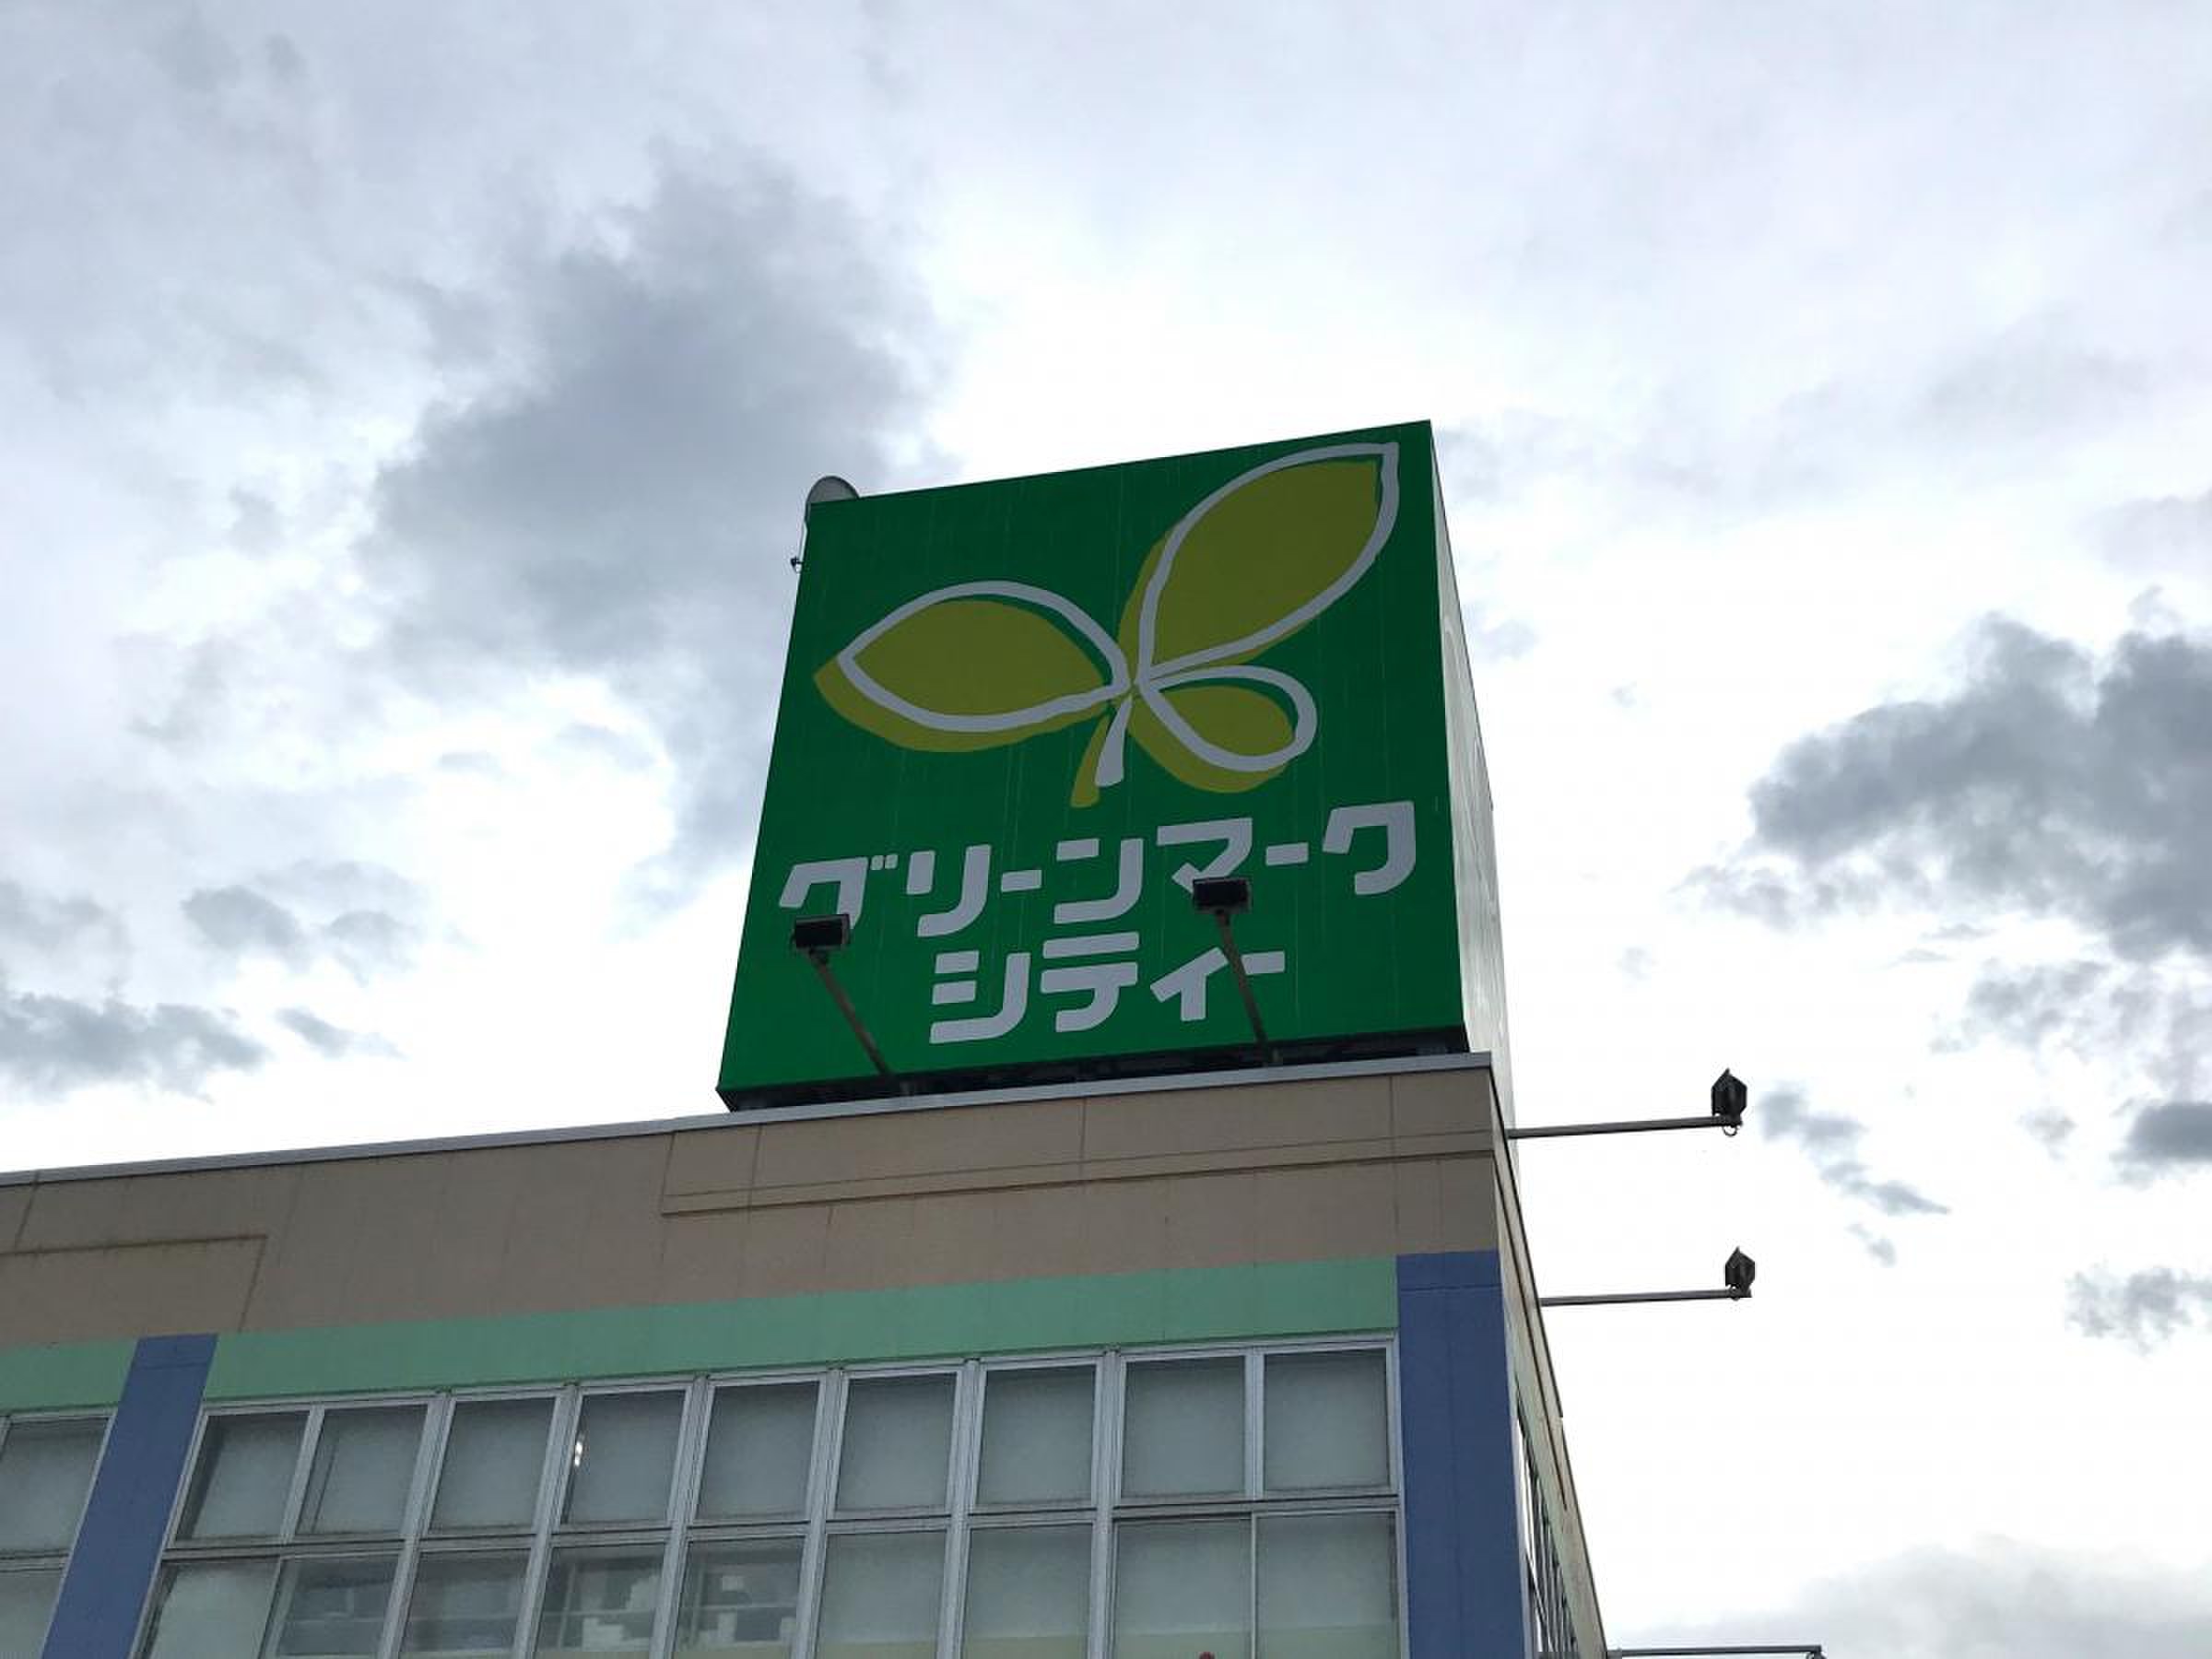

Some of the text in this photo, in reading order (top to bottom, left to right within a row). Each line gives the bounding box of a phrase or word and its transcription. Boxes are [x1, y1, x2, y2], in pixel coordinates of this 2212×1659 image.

[779, 801, 1416, 937] グリーンマーク
[929, 932, 1285, 1044] シティー
